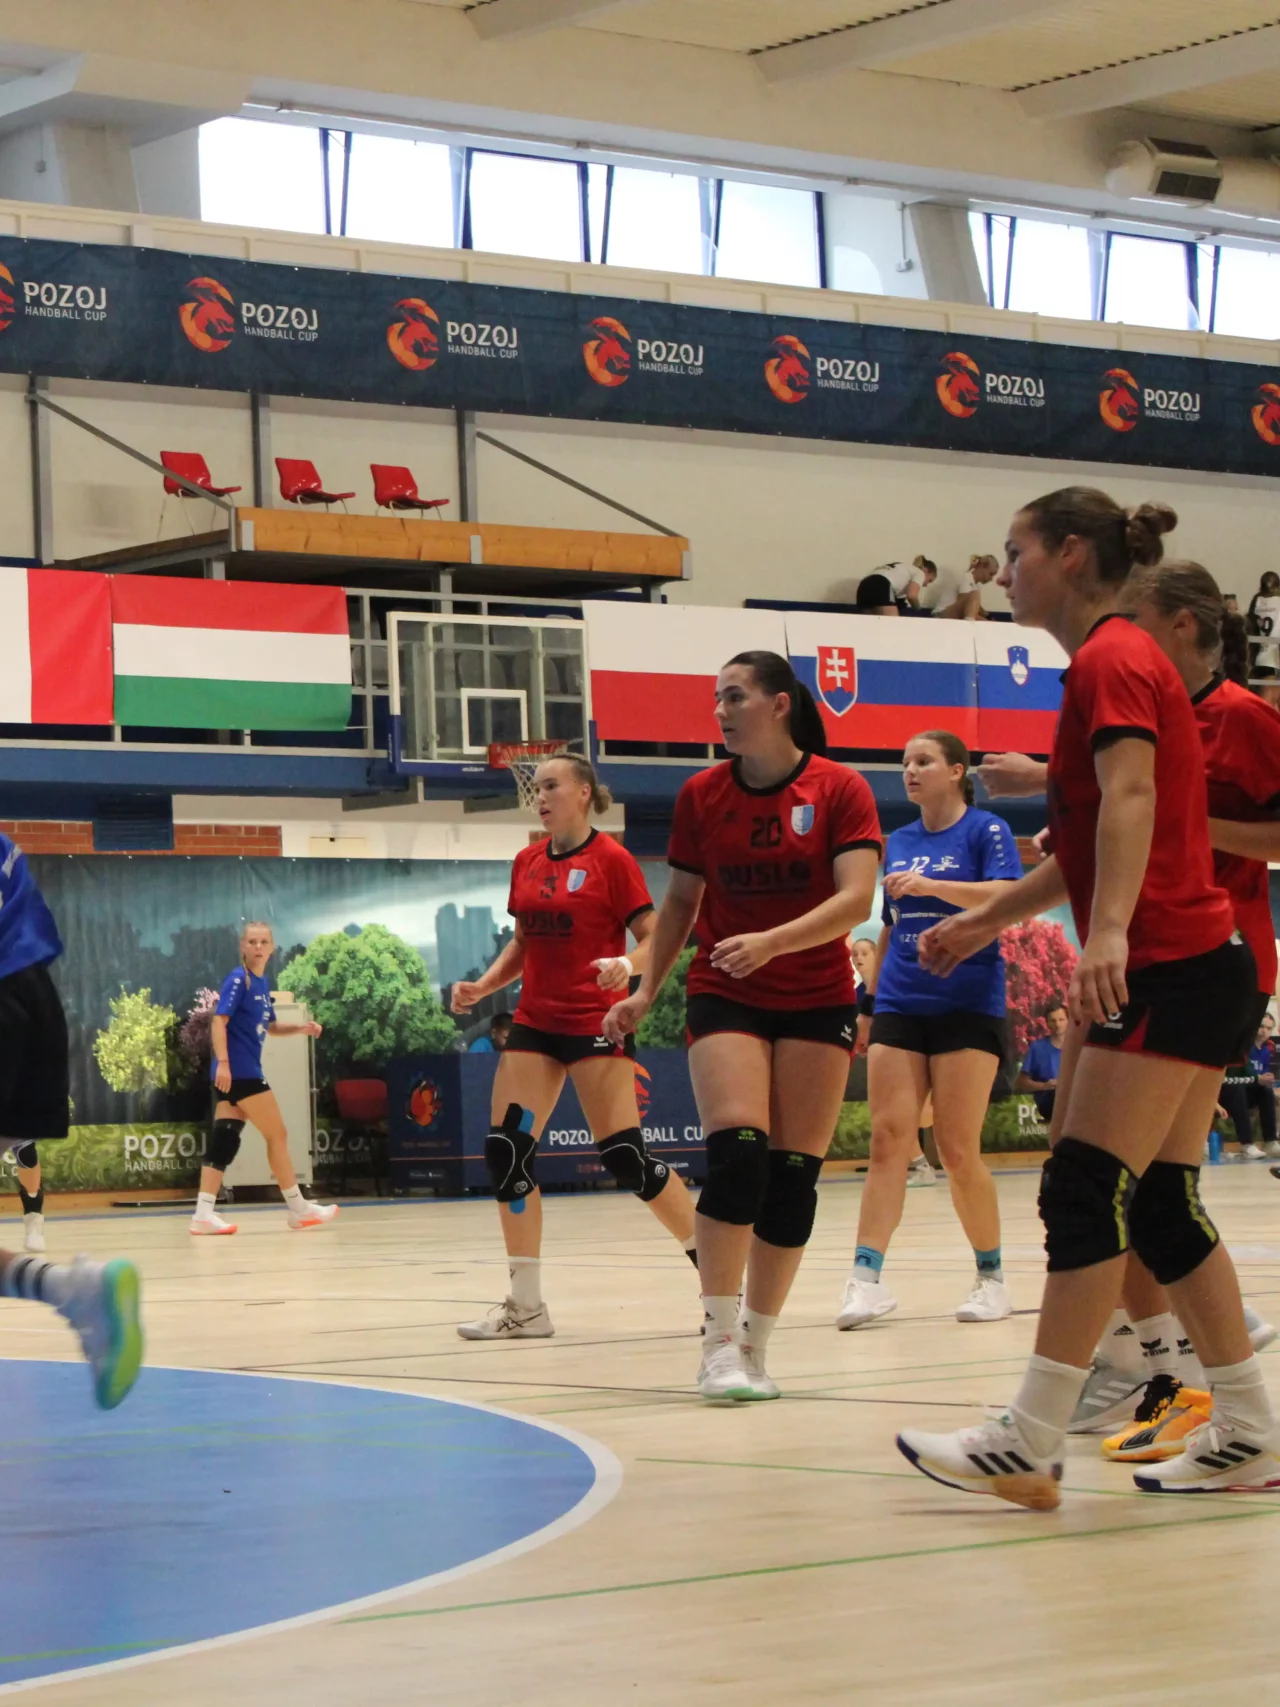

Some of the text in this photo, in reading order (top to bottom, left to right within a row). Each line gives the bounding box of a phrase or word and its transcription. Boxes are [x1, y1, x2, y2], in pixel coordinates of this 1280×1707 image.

[23, 282, 107, 310] POZOJ
[25, 306, 107, 322] HANDBALL CUP
[241, 303, 319, 331] POZOJ
[244, 326, 318, 343] HANDBALL CUP
[446, 321, 518, 349] POZOJ
[447, 345, 518, 359] HANDBALL CUP
[637, 338, 704, 366] POZOJ
[638, 362, 703, 376] HANDBALL CUP
[816, 357, 880, 383] POZOJ
[817, 379, 880, 393] HANDBALL CUP
[985, 373, 1045, 398] POZOJ
[986, 395, 1045, 408] HANDBALL CUP
[1143, 388, 1200, 413] POZOJ
[1145, 409, 1200, 422] HANDBALL CUP
[750, 815, 782, 848] 20
[910, 856, 930, 875] 12
[683, 1126, 705, 1142] CU
[124, 1133, 207, 1160] POZOJ
[124, 1159, 183, 1172] HANDBALL
